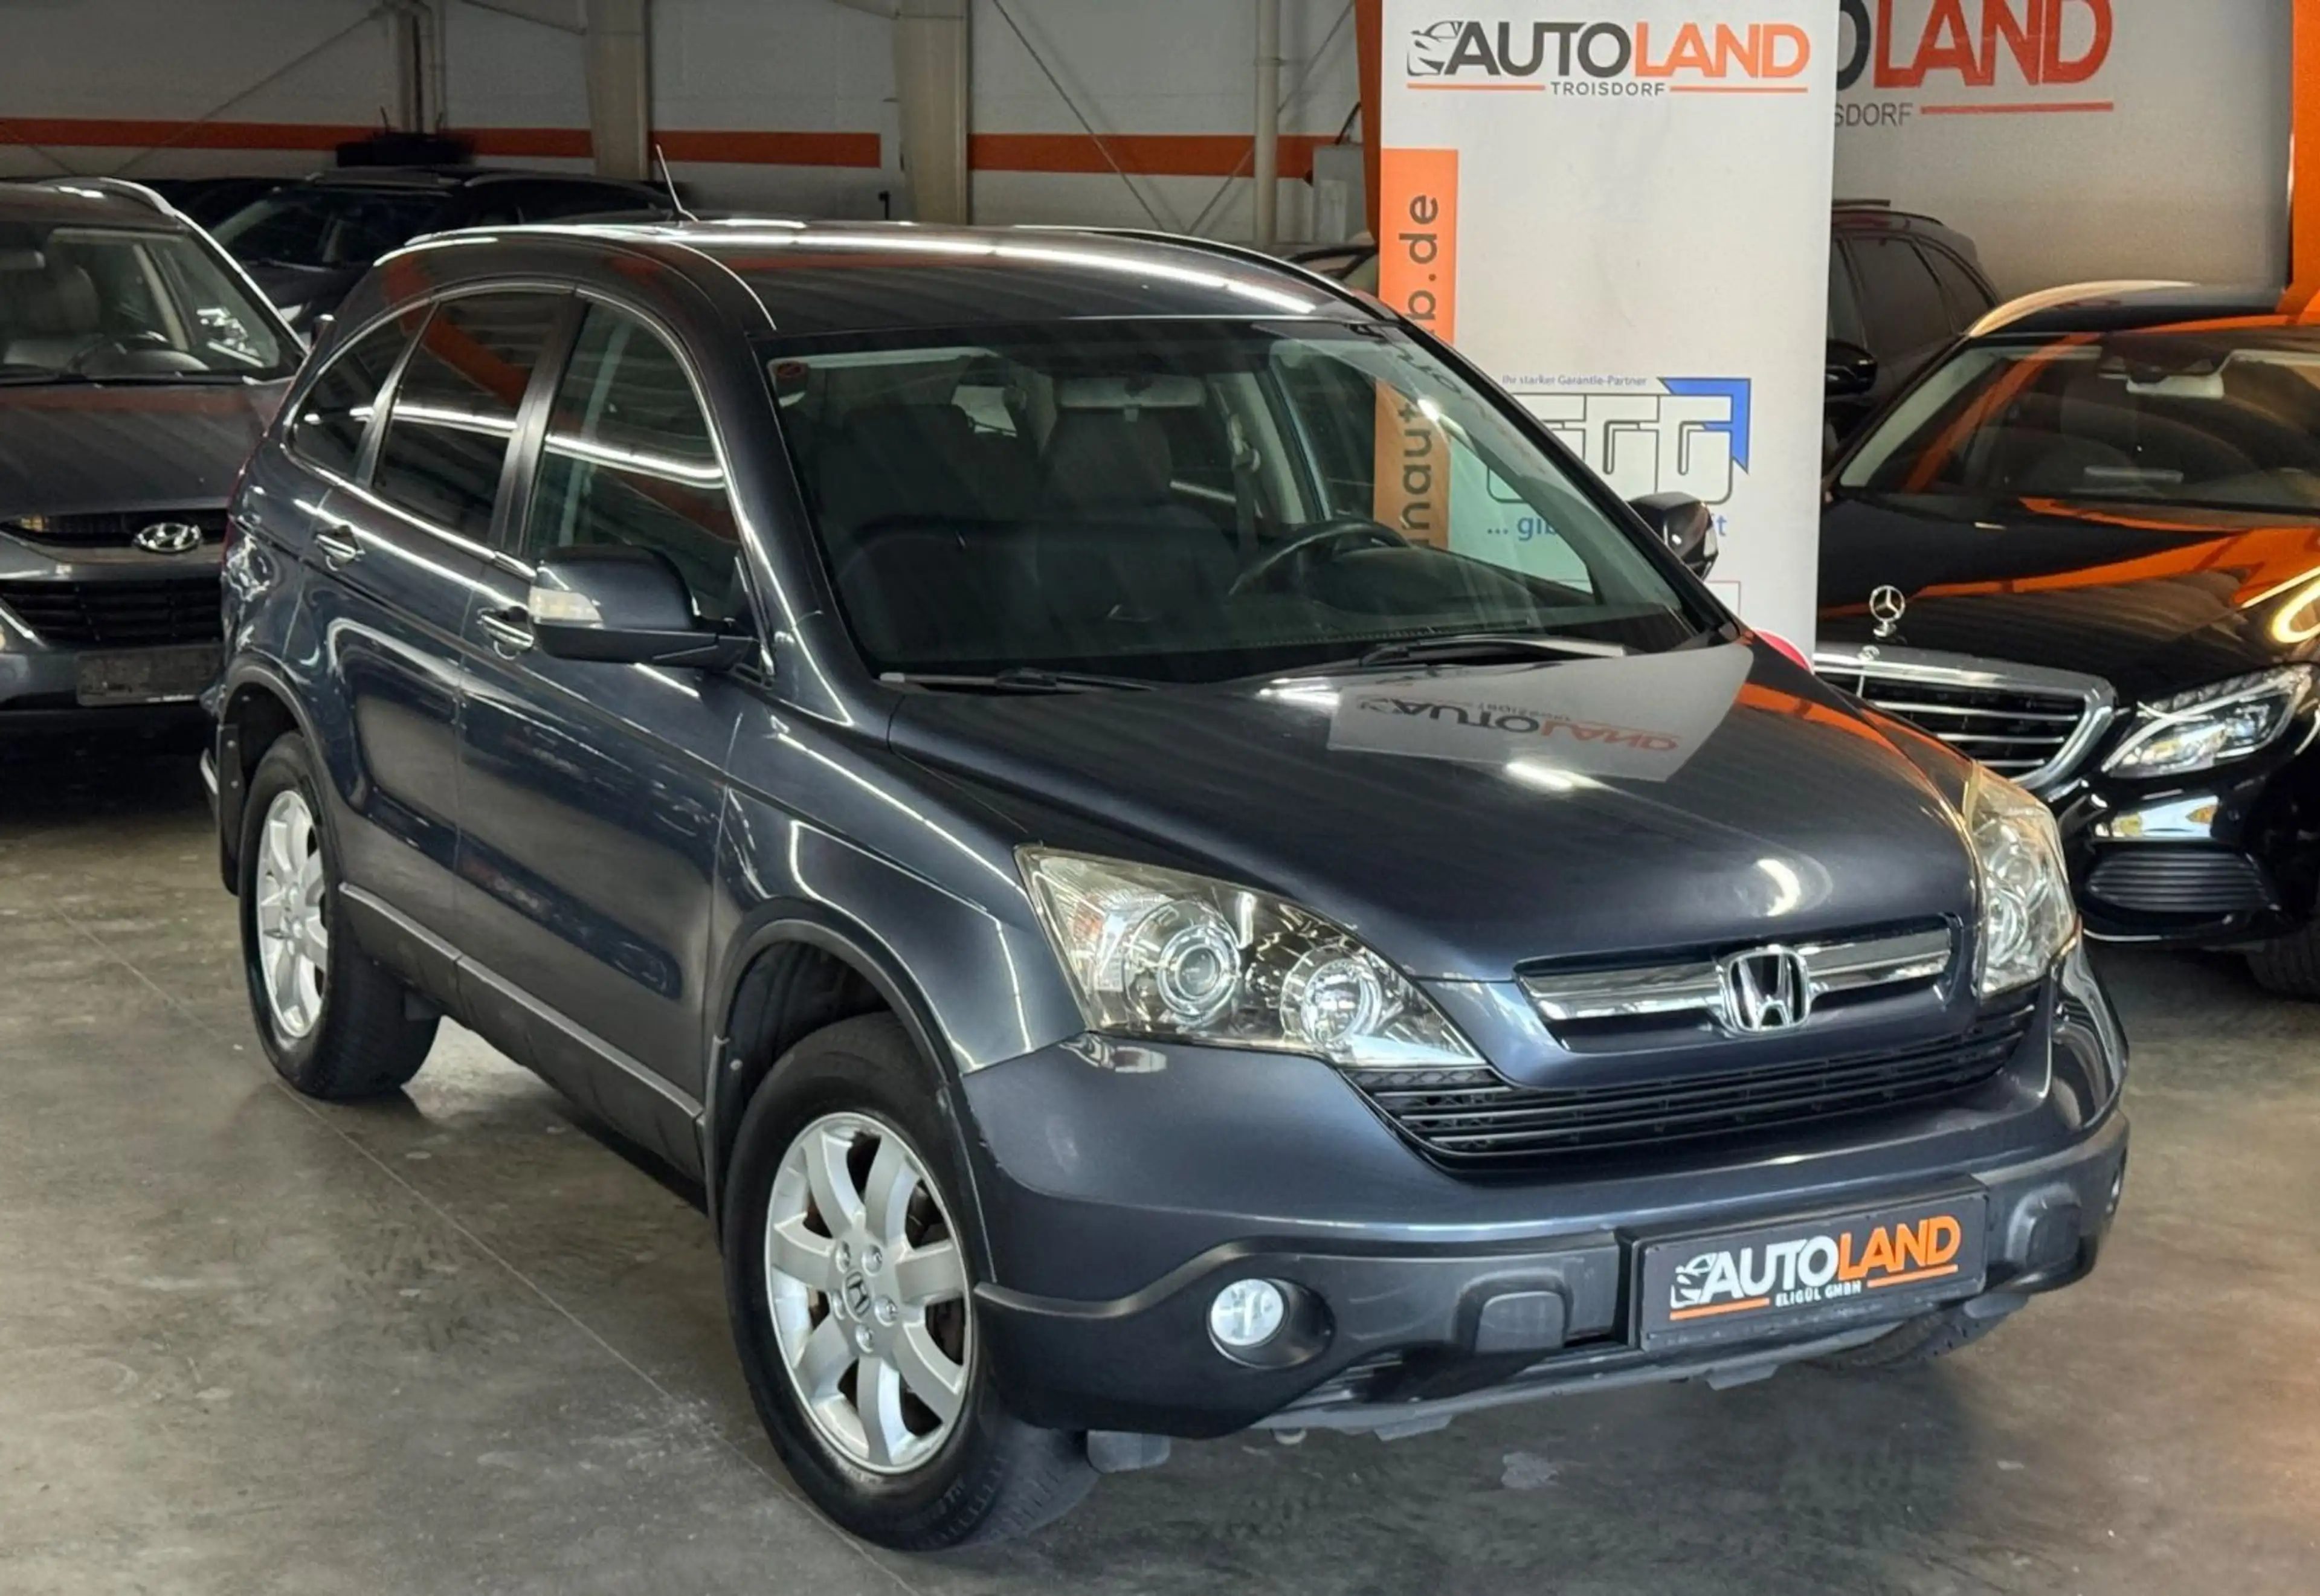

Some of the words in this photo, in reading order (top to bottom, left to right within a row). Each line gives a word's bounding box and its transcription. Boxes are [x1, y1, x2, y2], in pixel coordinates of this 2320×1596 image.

[1444, 21, 1811, 78] AUTOLAND
[1551, 81, 1666, 96] TROISDORF
[1502, 375, 1517, 385] Ihr
[1519, 375, 1556, 385] starker
[1557, 375, 1648, 387] Garantie-Partner
[1700, 1215, 1962, 1305] AUTOLAND
